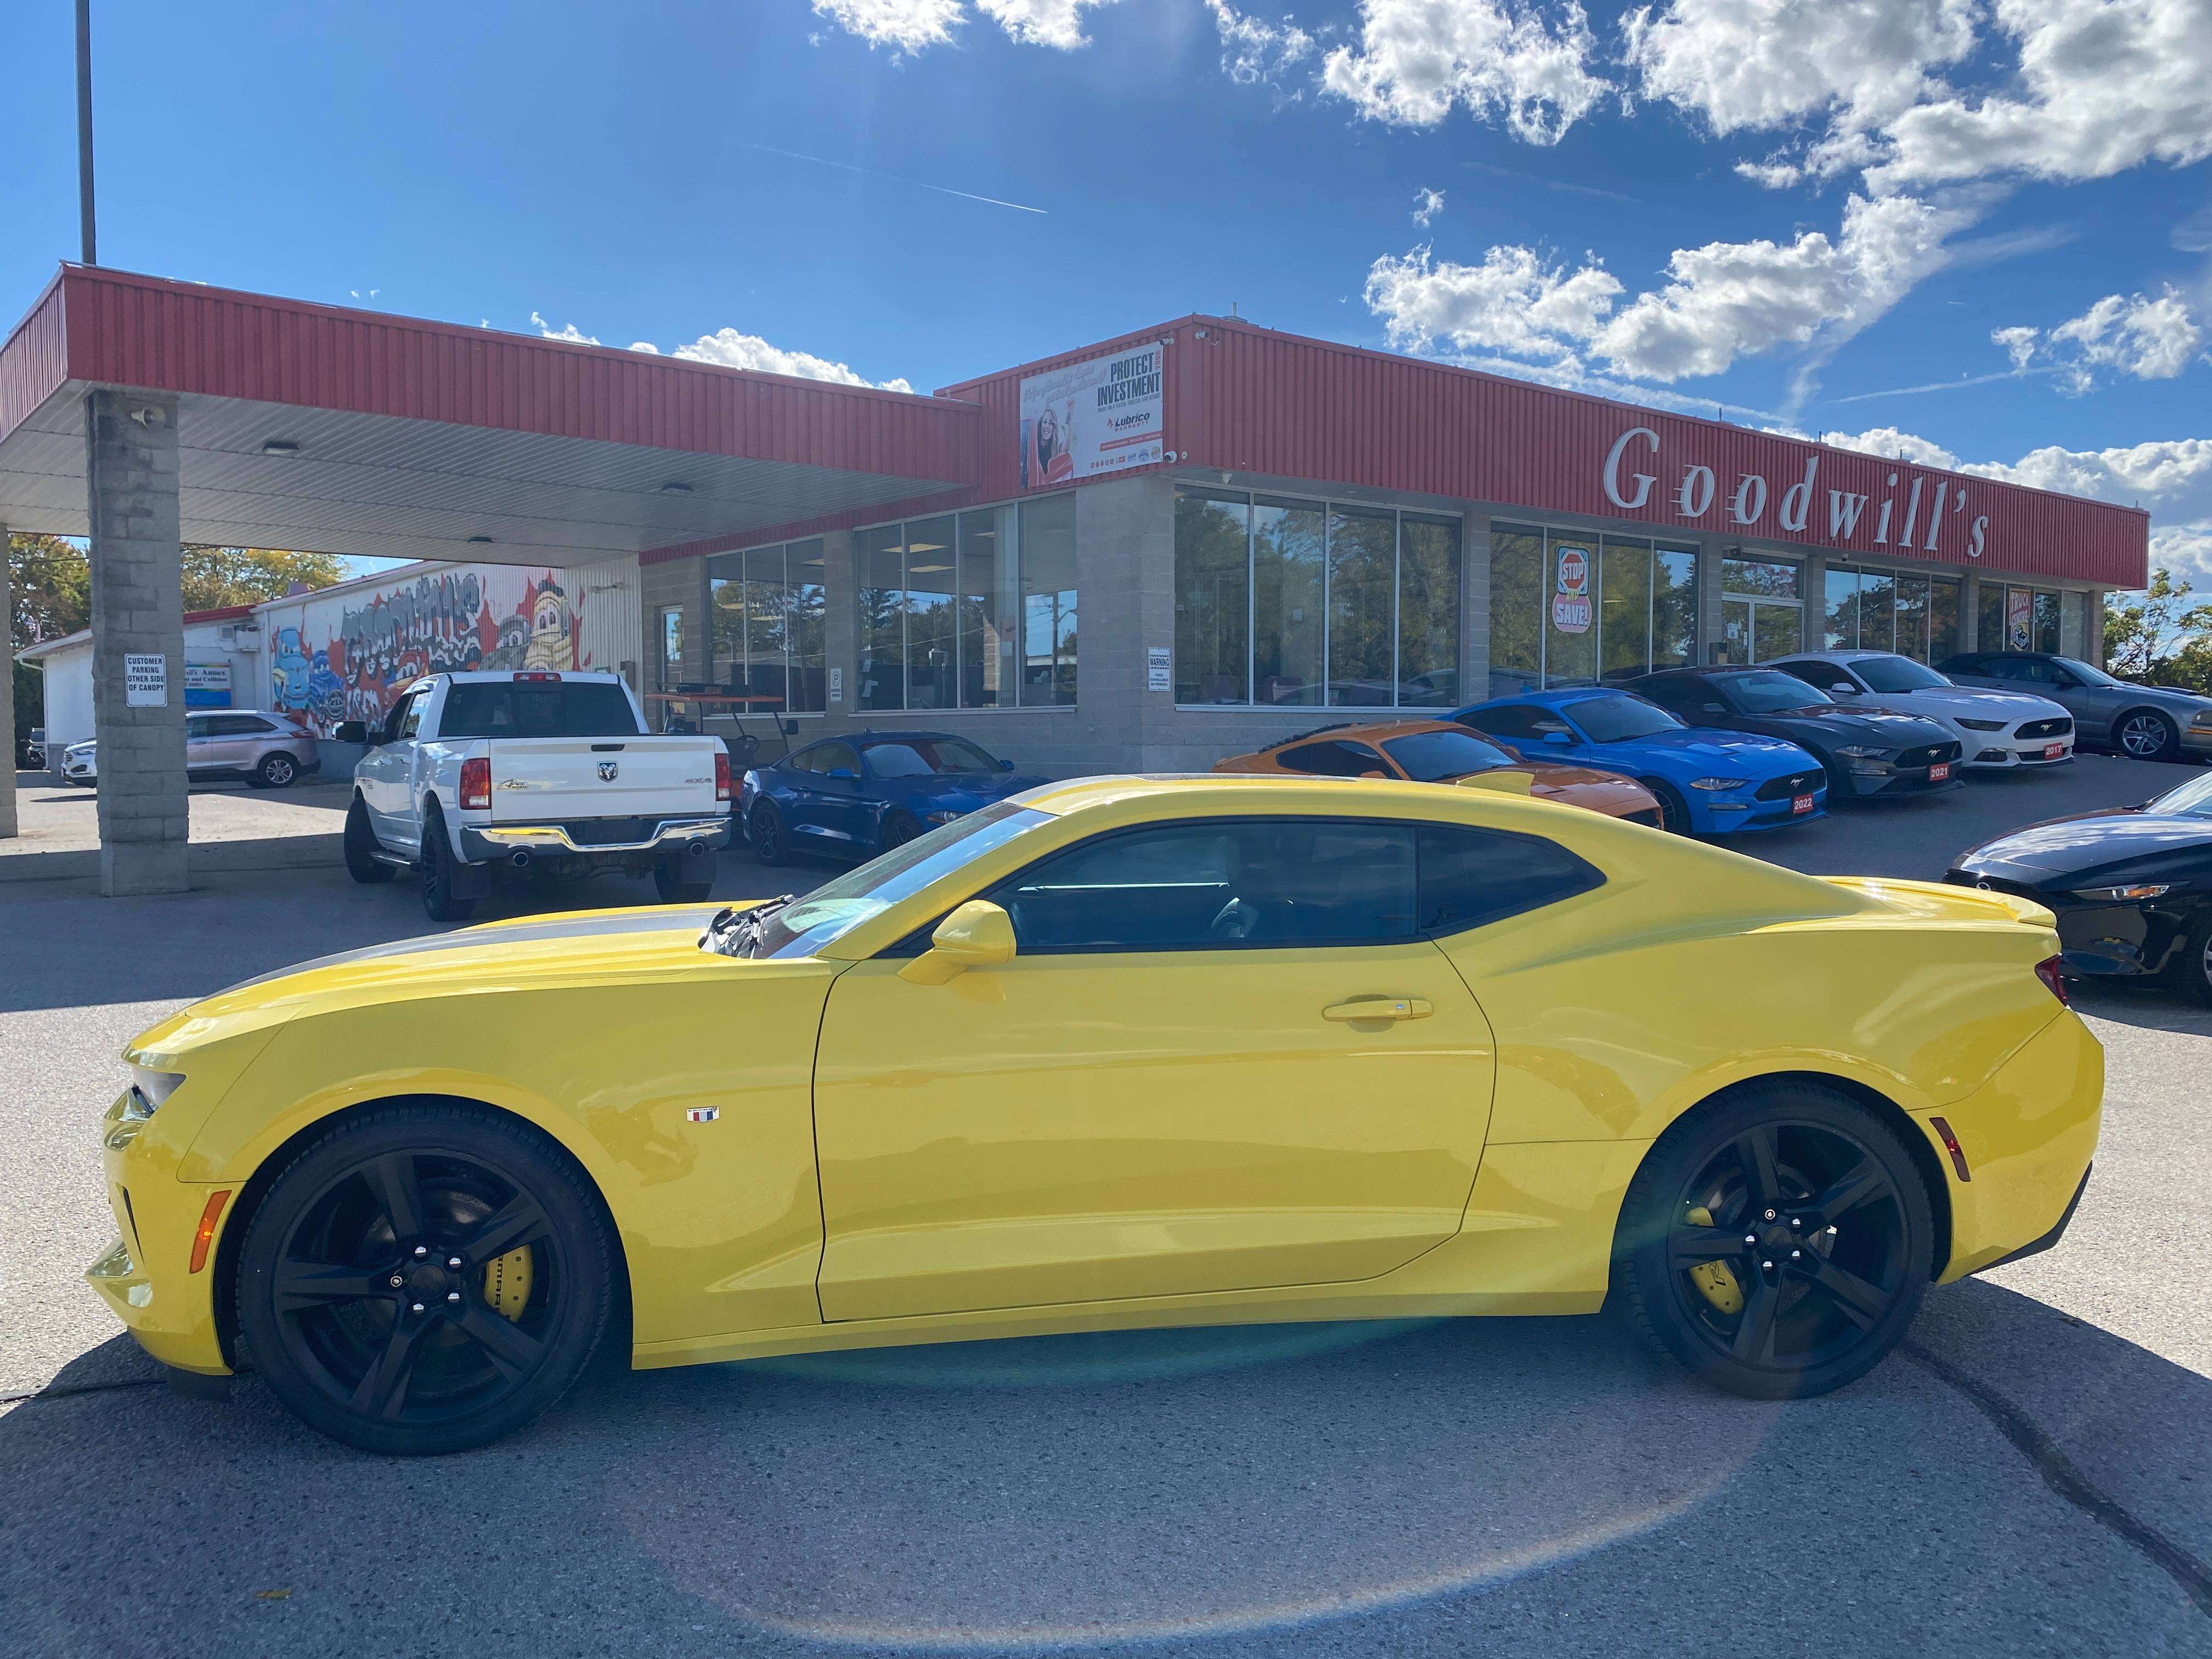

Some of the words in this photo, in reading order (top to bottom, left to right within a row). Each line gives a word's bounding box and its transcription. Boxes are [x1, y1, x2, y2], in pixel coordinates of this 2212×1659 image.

[1111, 352, 1154, 382] PROTECT
[1098, 372, 1160, 407] INVESTMENT
[1115, 413, 1150, 427] Lubrico
[1115, 420, 1149, 432] WARRANTY
[1603, 427, 1988, 558] Goodwill's
[1562, 562, 1584, 580] STOP
[2010, 592, 2029, 613] TRUCK
[1556, 603, 1589, 626] SAVE!
[1149, 658, 1169, 667] WARNING
[2046, 745, 2062, 755] 2017
[1931, 767, 1948, 777] 2021
[1795, 797, 1812, 810] 2022
